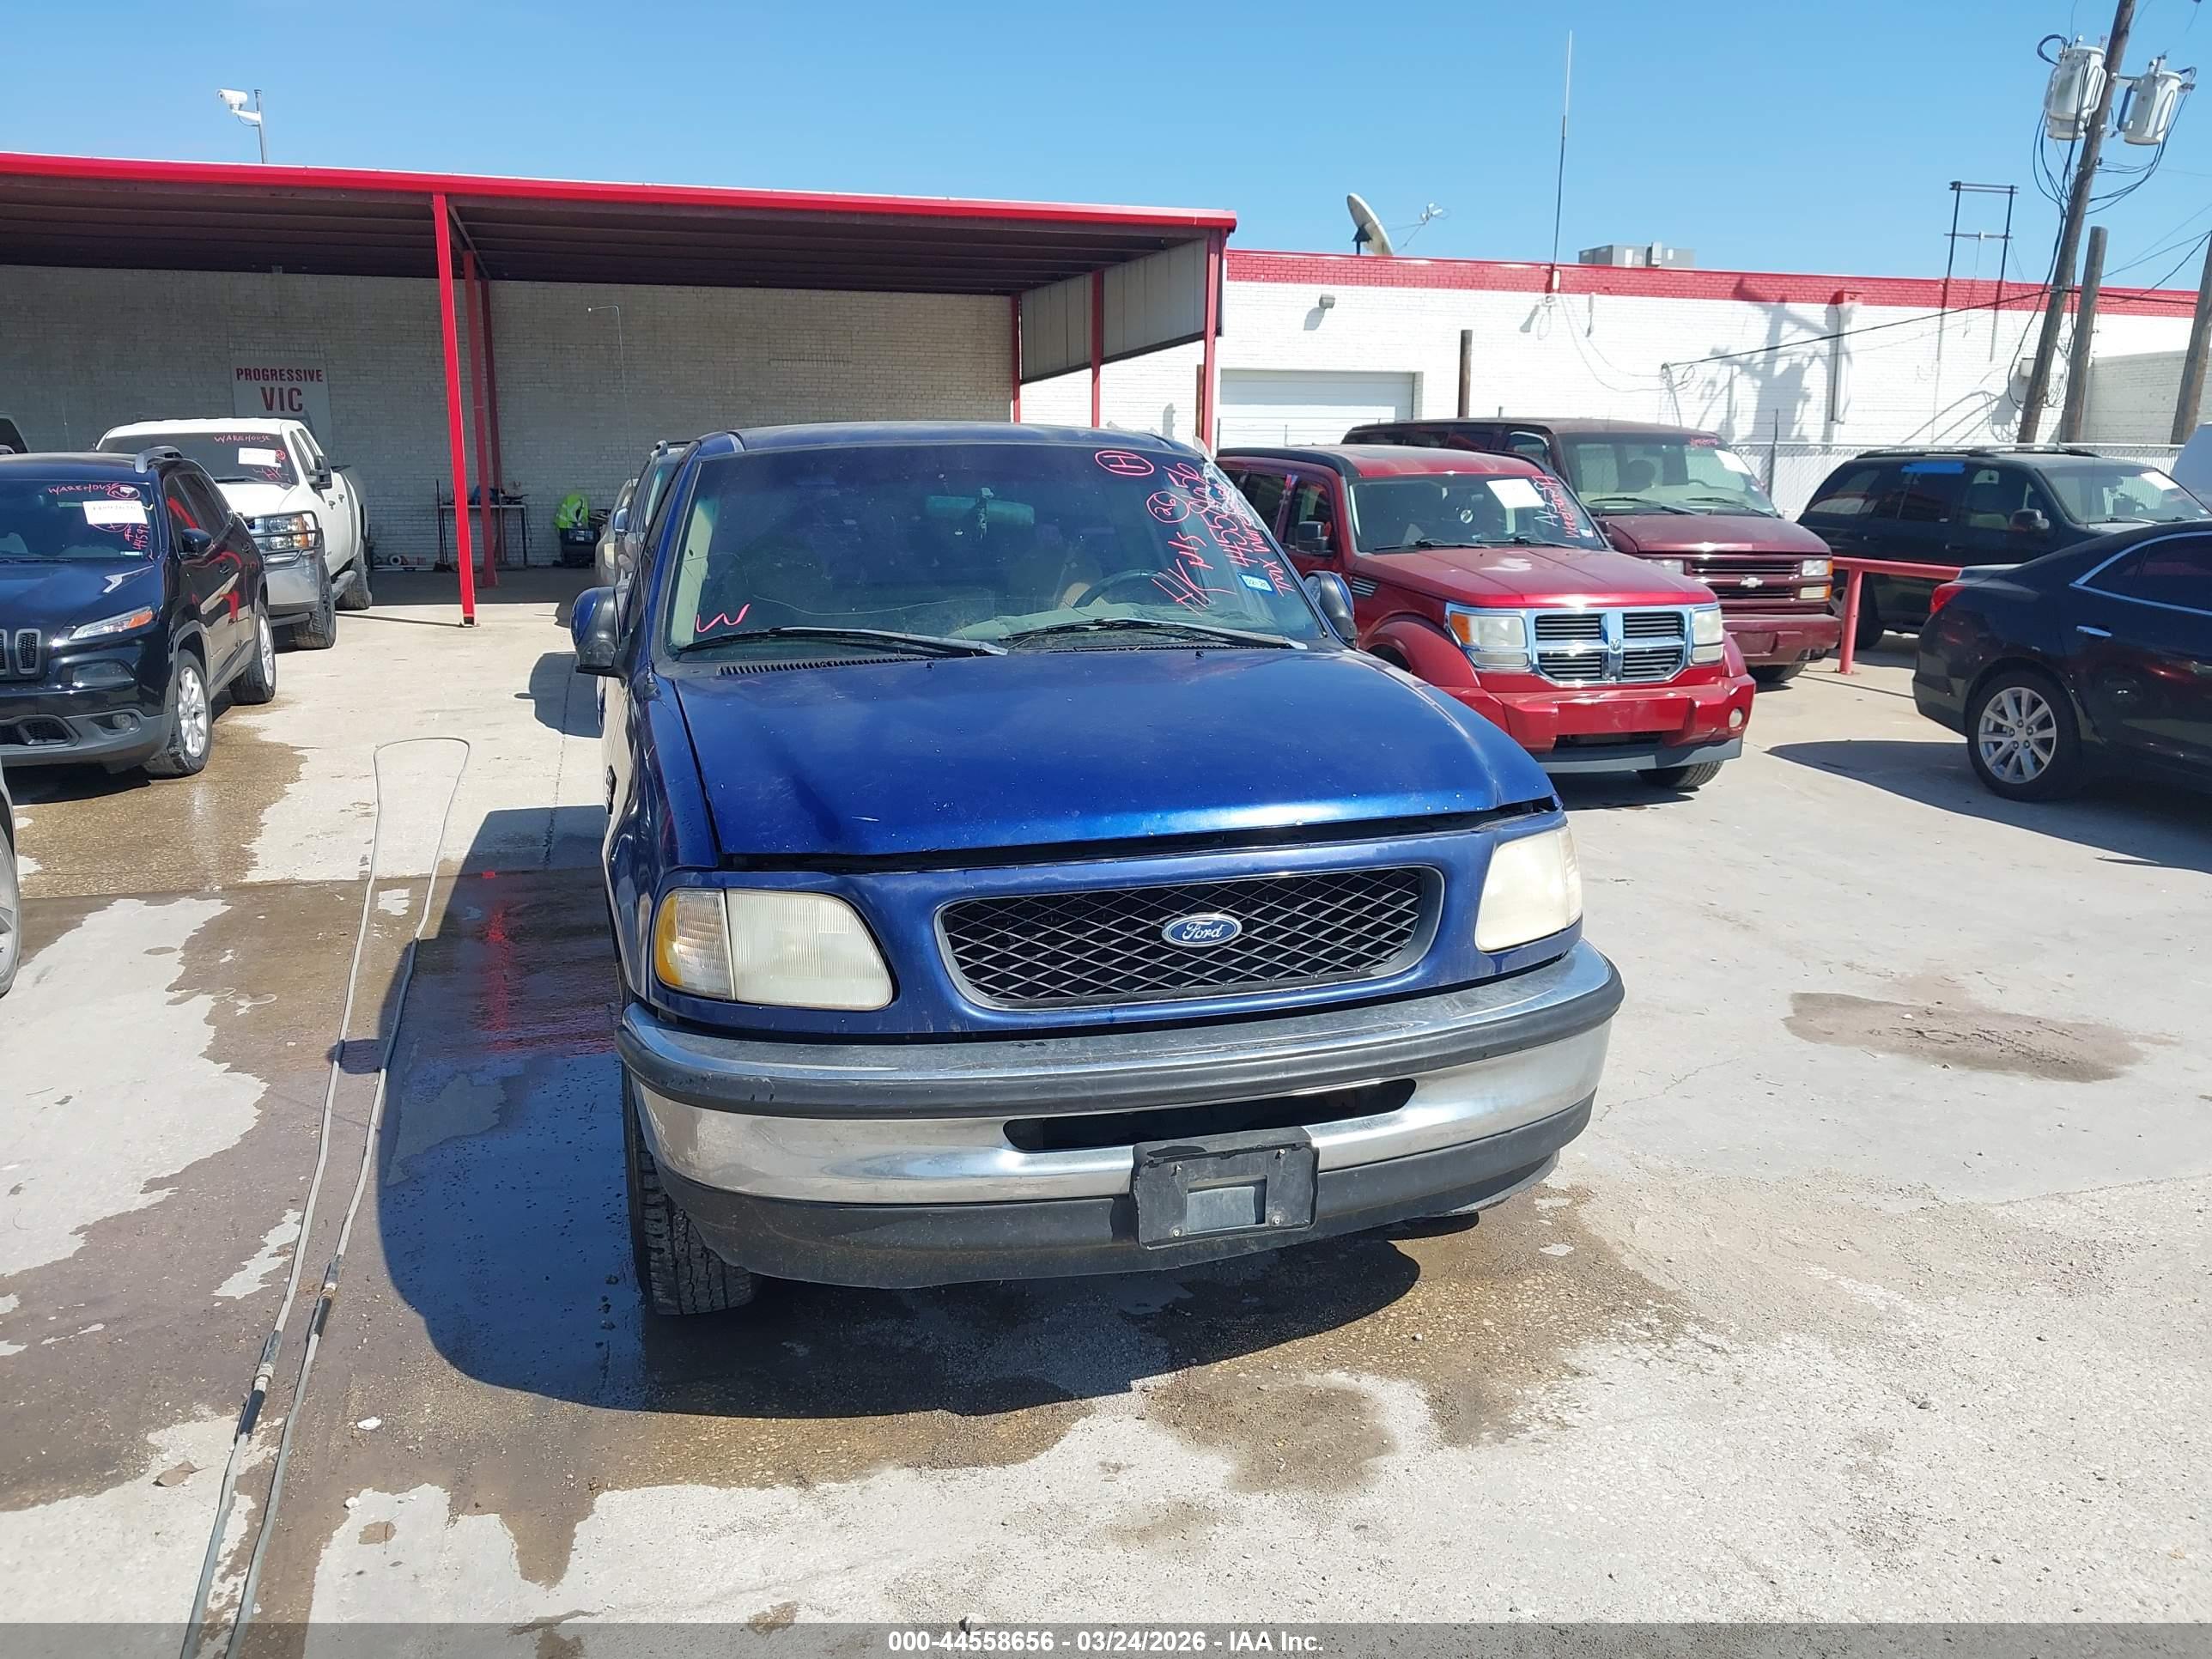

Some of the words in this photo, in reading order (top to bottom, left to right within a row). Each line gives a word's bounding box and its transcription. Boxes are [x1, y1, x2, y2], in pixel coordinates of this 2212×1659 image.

[236, 368, 324, 382] PROGRESSIVE
[260, 386, 303, 412] VIC
[1182, 921, 1228, 940] Ford
